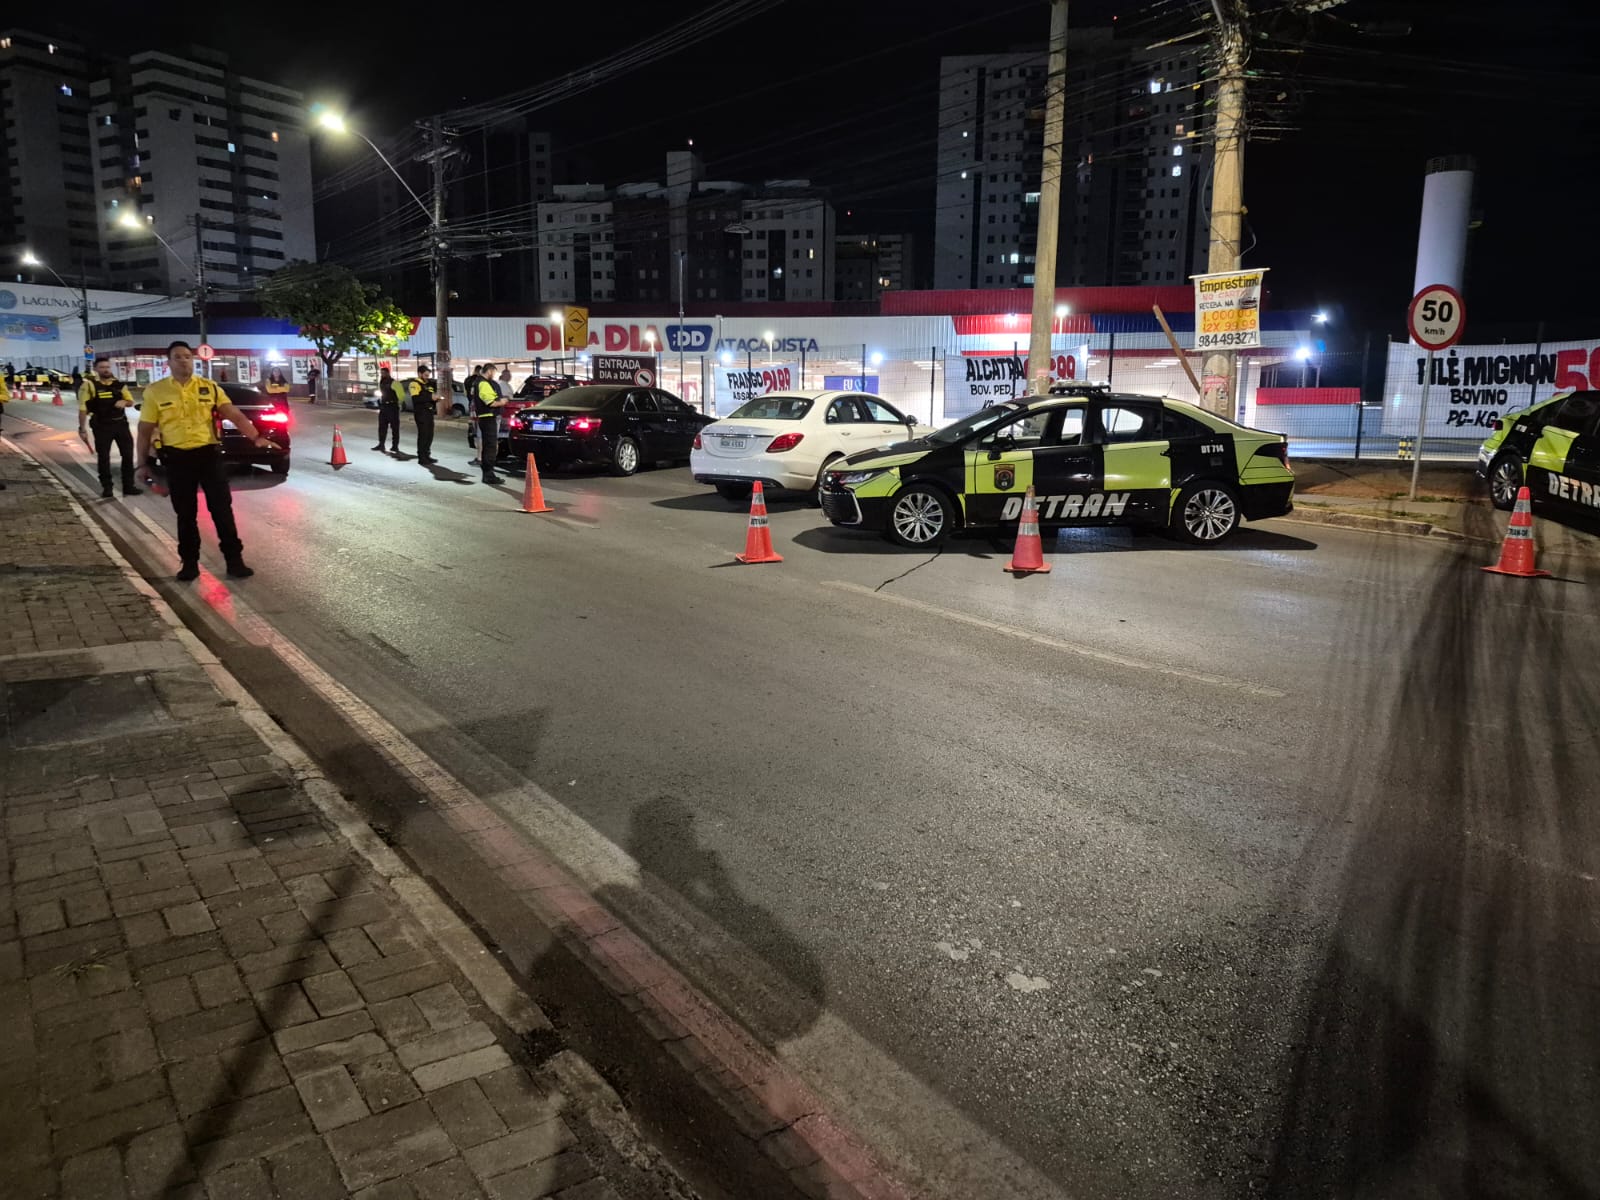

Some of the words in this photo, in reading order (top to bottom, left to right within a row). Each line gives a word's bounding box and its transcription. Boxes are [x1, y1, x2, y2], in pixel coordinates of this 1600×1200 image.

[22, 296, 70, 309] LAGUNA
[74, 300, 102, 312] MLL
[1422, 299, 1453, 323] 50
[526, 324, 587, 352] DI
[604, 324, 664, 352] DIA
[715, 338, 819, 353] ATACADISTA
[1424, 326, 1446, 336] km/h
[598, 358, 641, 370] ENTRADA
[966, 357, 1025, 382] ALCATRA
[1463, 353, 1557, 387] MIGNON
[599, 371, 612, 380] DIA
[613, 372, 618, 380] a
[619, 371, 632, 381] DIA
[727, 371, 764, 389] FRANGO
[970, 384, 991, 396] BOV.
[1450, 388, 1508, 406] BOVINO
